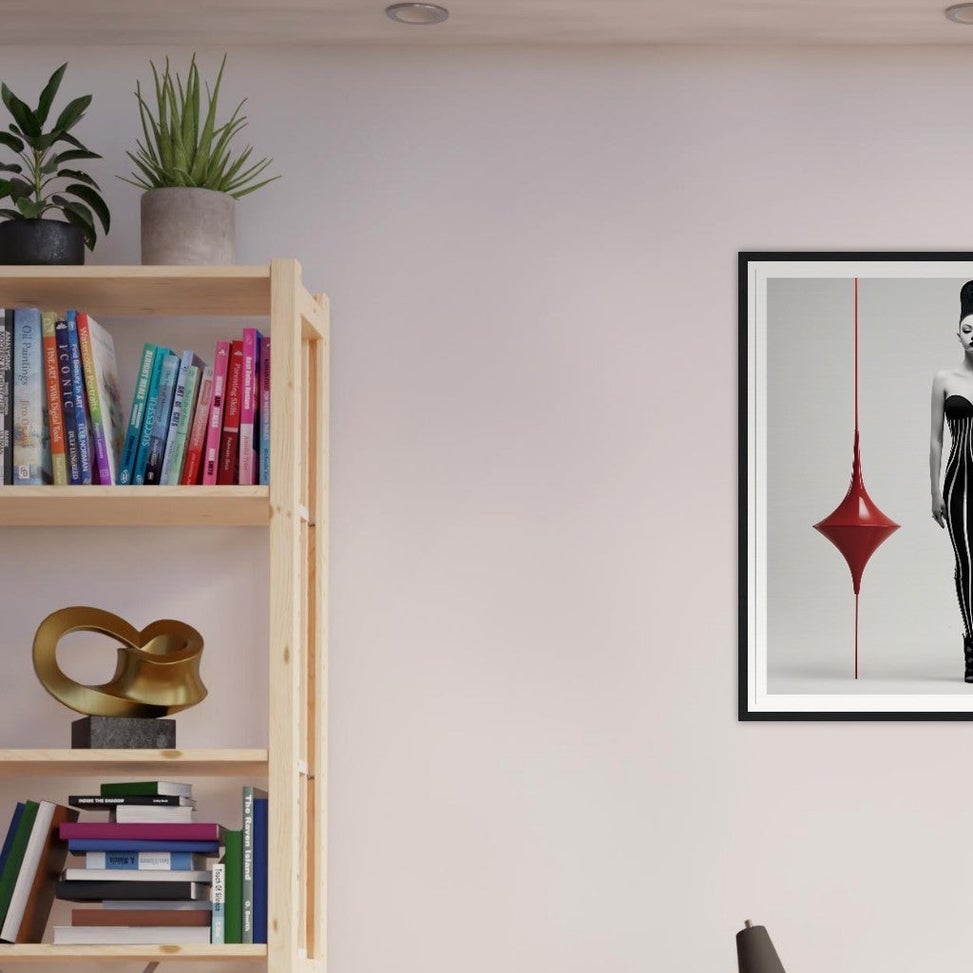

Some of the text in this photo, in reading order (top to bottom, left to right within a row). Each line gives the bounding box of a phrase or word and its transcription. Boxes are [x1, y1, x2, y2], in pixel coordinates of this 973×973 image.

[19, 325, 32, 386] Oil Paintings
[79, 326, 94, 373] Watercolor
[48, 365, 56, 379] ART
[86, 375, 99, 412] Portraits
[49, 402, 59, 424] Digital
[140, 396, 157, 447] SUCCESSFUL
[52, 426, 60, 442] Tools
